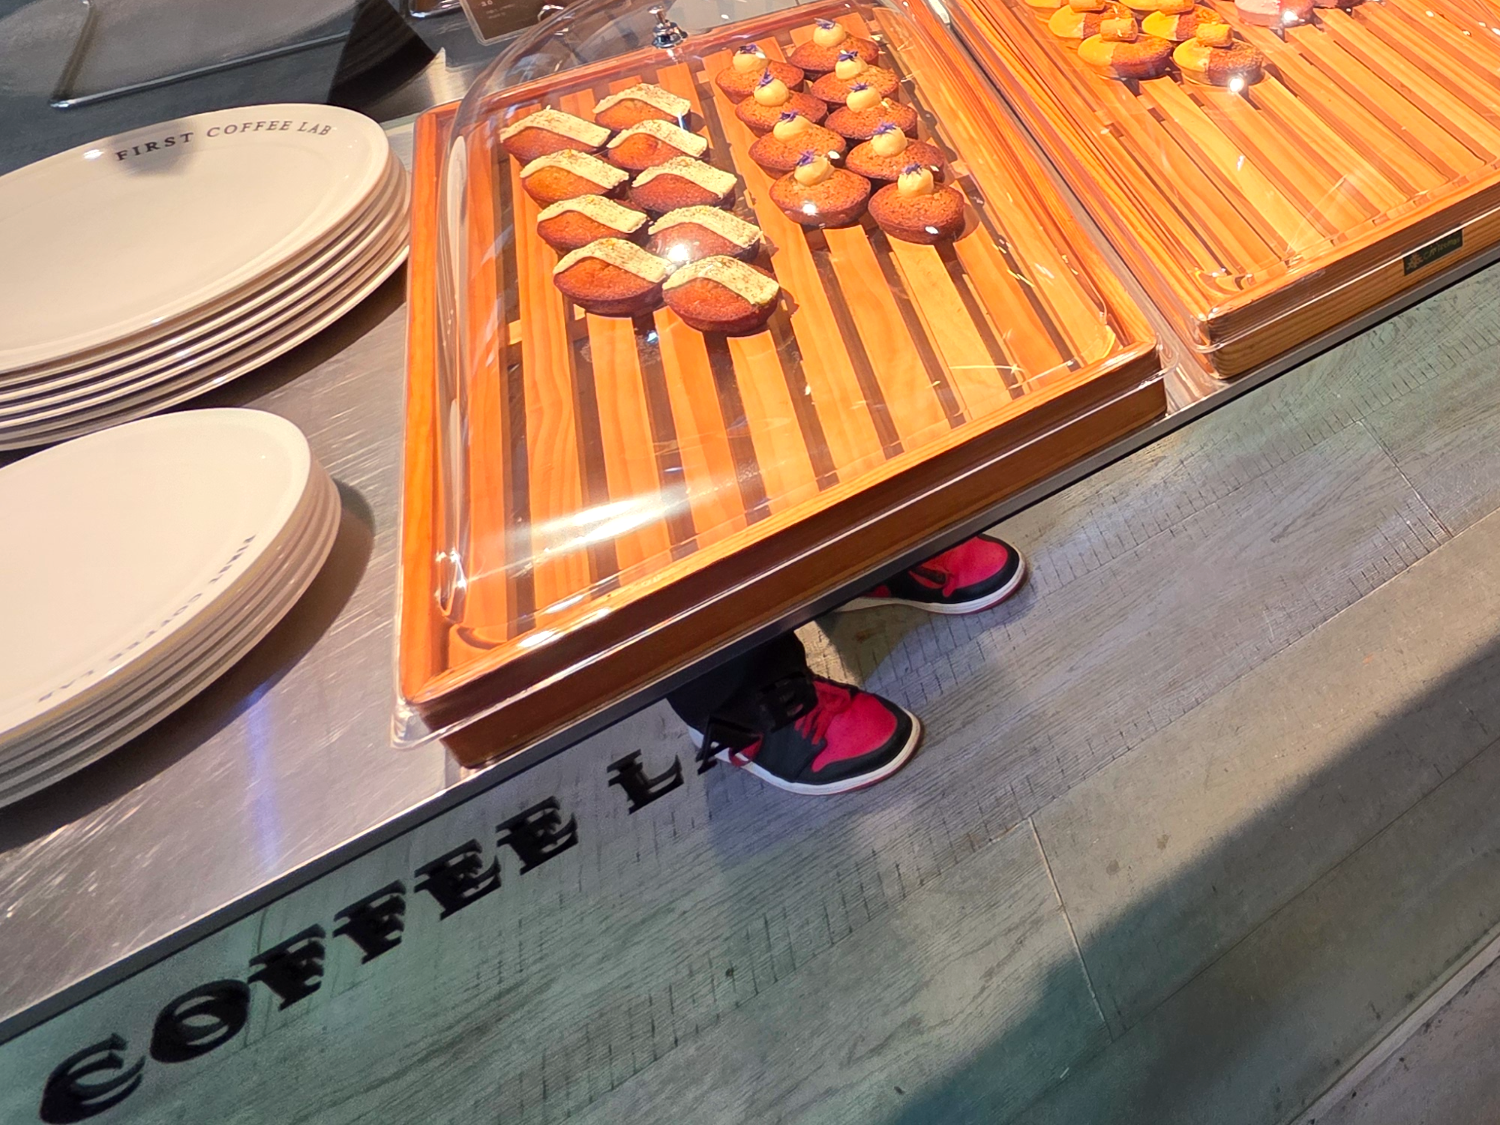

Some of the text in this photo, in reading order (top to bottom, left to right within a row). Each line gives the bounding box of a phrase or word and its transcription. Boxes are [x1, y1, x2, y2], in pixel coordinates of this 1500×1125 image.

[115, 121, 333, 161] FIRST COFFEE LAB
[39, 795, 579, 1125] COFFEE
